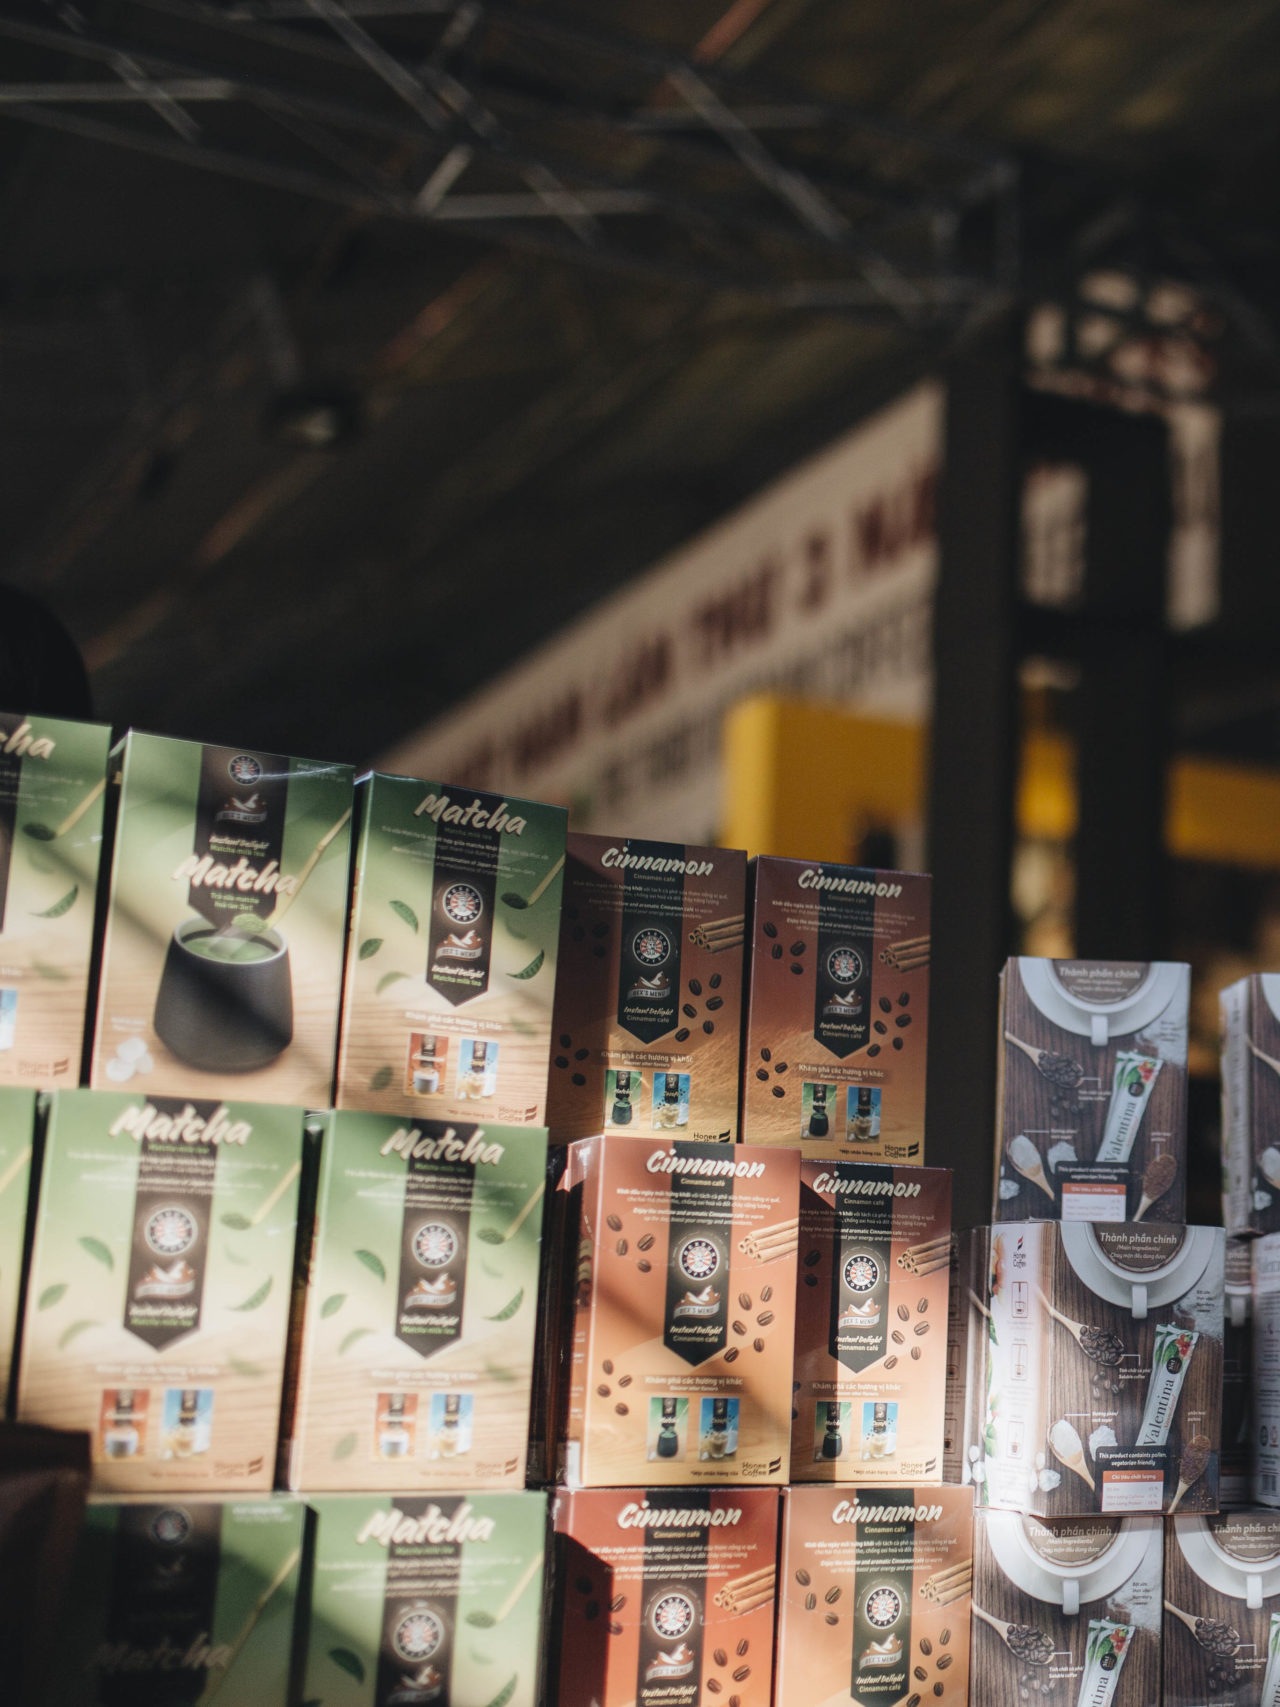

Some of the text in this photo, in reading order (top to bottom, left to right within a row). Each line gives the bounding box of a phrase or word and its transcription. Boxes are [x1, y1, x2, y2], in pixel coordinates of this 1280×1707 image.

[413, 794, 527, 836] Matcha
[172, 853, 299, 895] Matcha
[601, 847, 714, 877] Cinnamon
[798, 868, 902, 898] Cinnamon
[1059, 967, 1088, 978] Thành
[1110, 968, 1141, 979] chính
[109, 1103, 252, 1146] Matcha
[1104, 1102, 1137, 1162] Valentina
[380, 1126, 505, 1166] Matcha
[646, 1148, 766, 1179] Cinnamon
[812, 1171, 921, 1198] Cinnamon
[1100, 1232, 1177, 1244] Thành phần chính
[1143, 1379, 1174, 1445] Valentina
[357, 1504, 496, 1547] Matcha
[617, 1500, 742, 1529] Cinnamon
[832, 1498, 943, 1525] Cinnamon
[1029, 1525, 1112, 1538] Thành phần chính
[1214, 1524, 1242, 1534] Thành
[1244, 1524, 1266, 1537] phần
